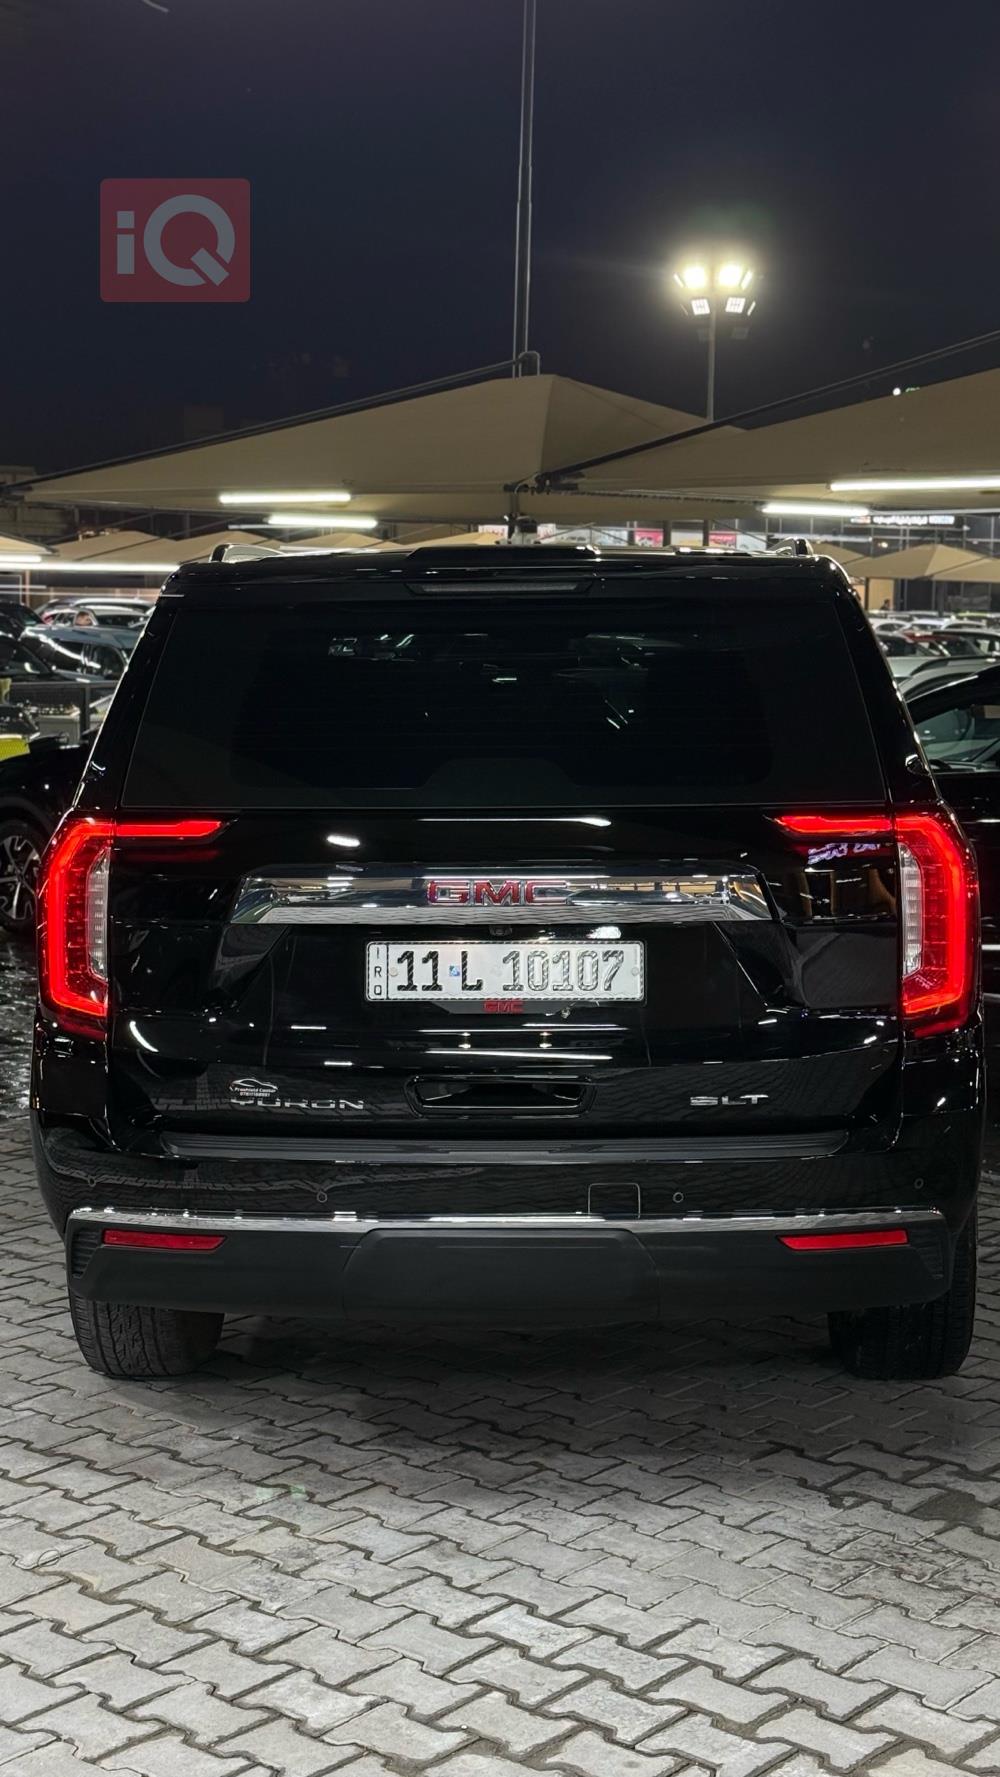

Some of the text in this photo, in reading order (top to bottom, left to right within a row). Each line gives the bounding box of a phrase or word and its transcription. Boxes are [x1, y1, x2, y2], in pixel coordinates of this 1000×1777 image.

[427, 880, 567, 905] GMC
[397, 951, 624, 992] 11 L 10107
[483, 1000, 524, 1012] GMC
[690, 1094, 769, 1105] SLT
